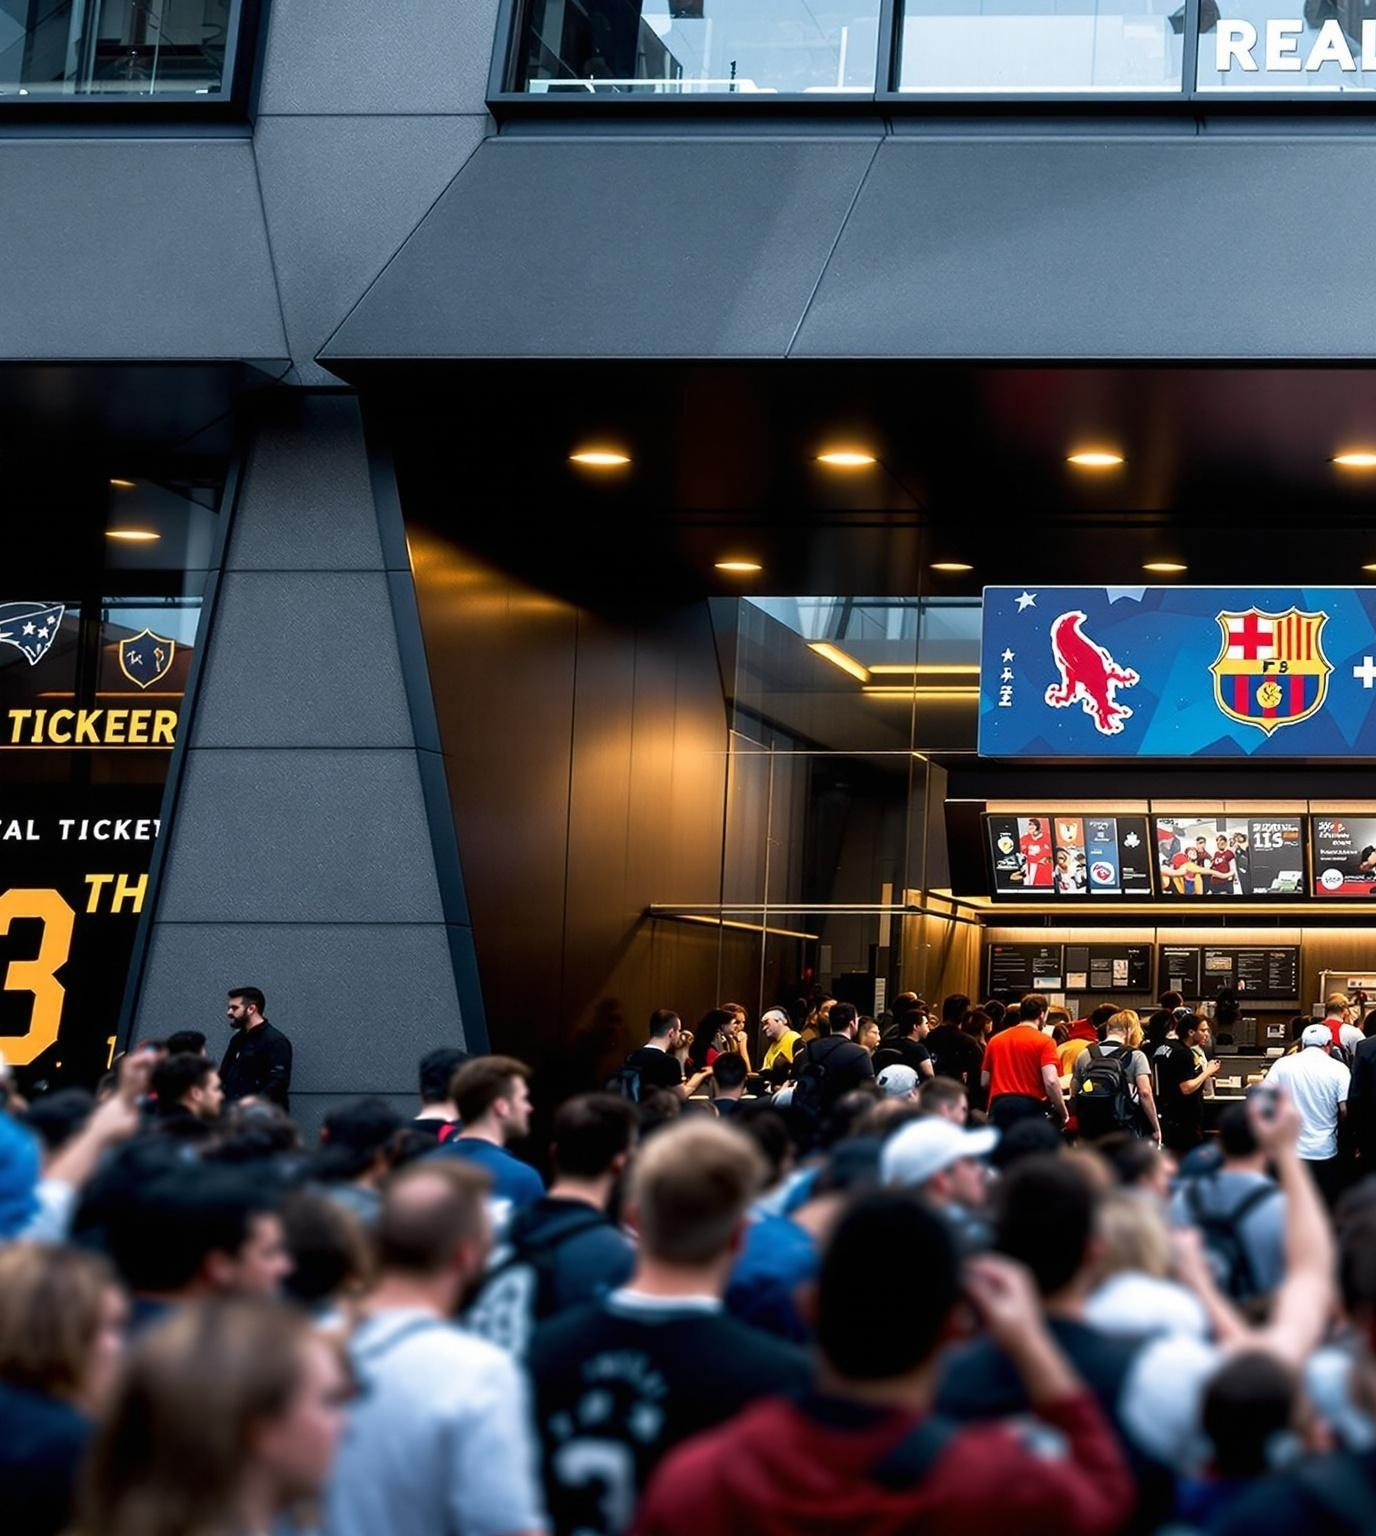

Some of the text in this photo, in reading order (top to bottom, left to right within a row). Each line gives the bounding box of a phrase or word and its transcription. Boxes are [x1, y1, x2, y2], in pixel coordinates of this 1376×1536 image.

[8, 709, 178, 744] TICKEER
[0, 819, 41, 841] AL
[84, 873, 149, 913] TH
